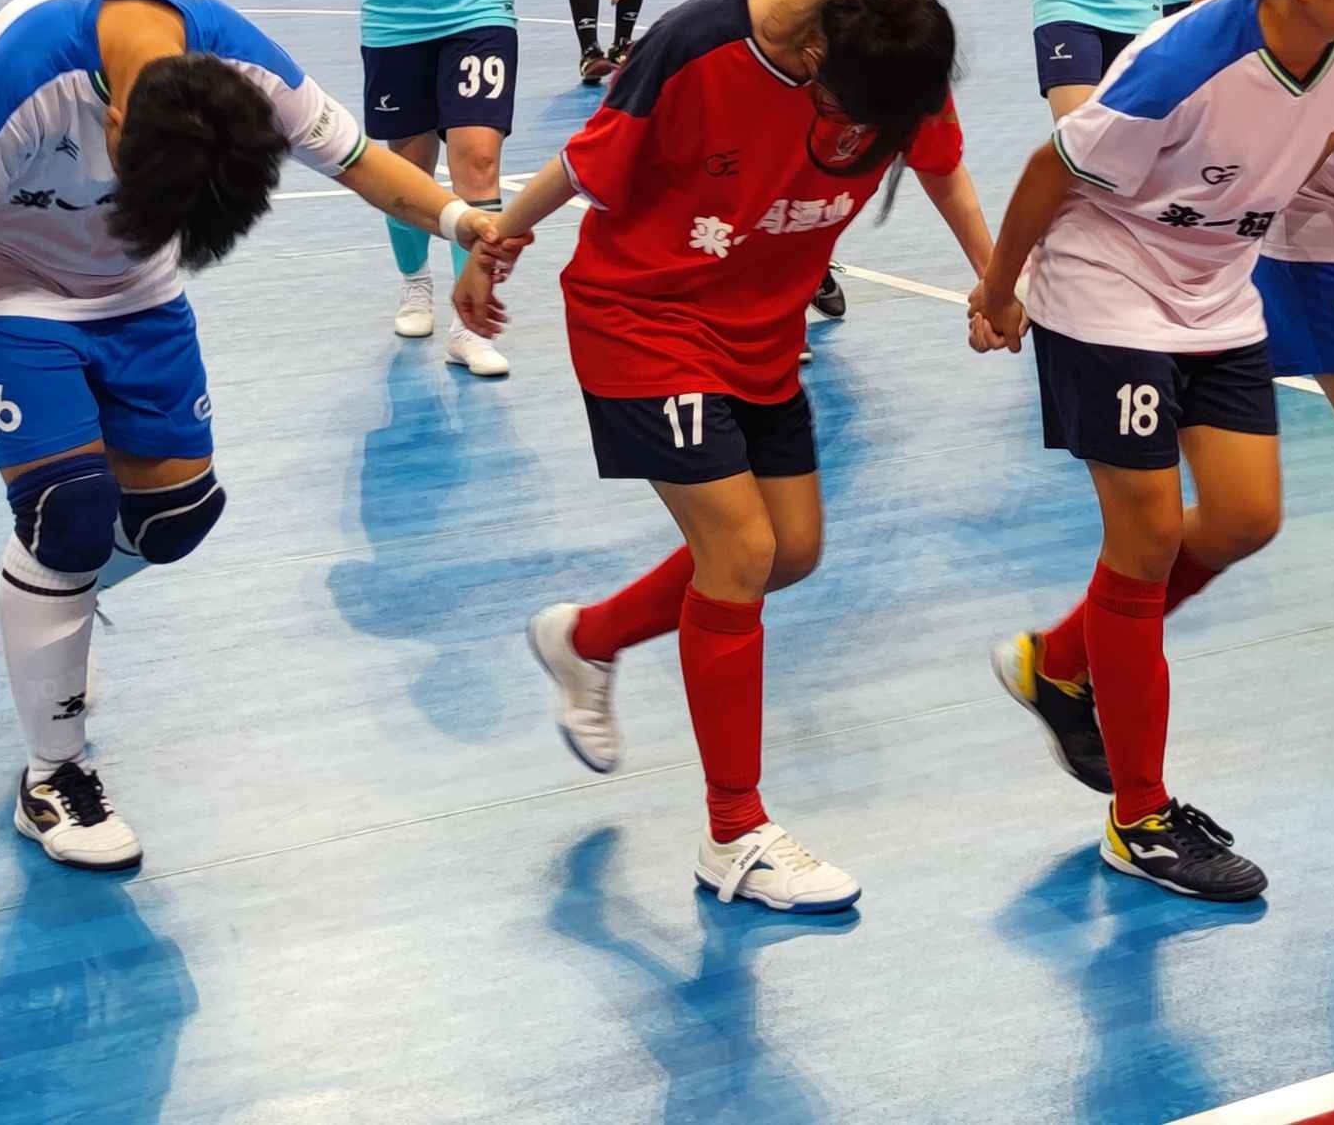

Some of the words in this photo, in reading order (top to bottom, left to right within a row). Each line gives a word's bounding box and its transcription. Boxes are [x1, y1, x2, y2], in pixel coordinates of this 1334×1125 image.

[458, 55, 506, 100] 39
[663, 392, 704, 449] 17
[1116, 383, 1160, 437] 18
